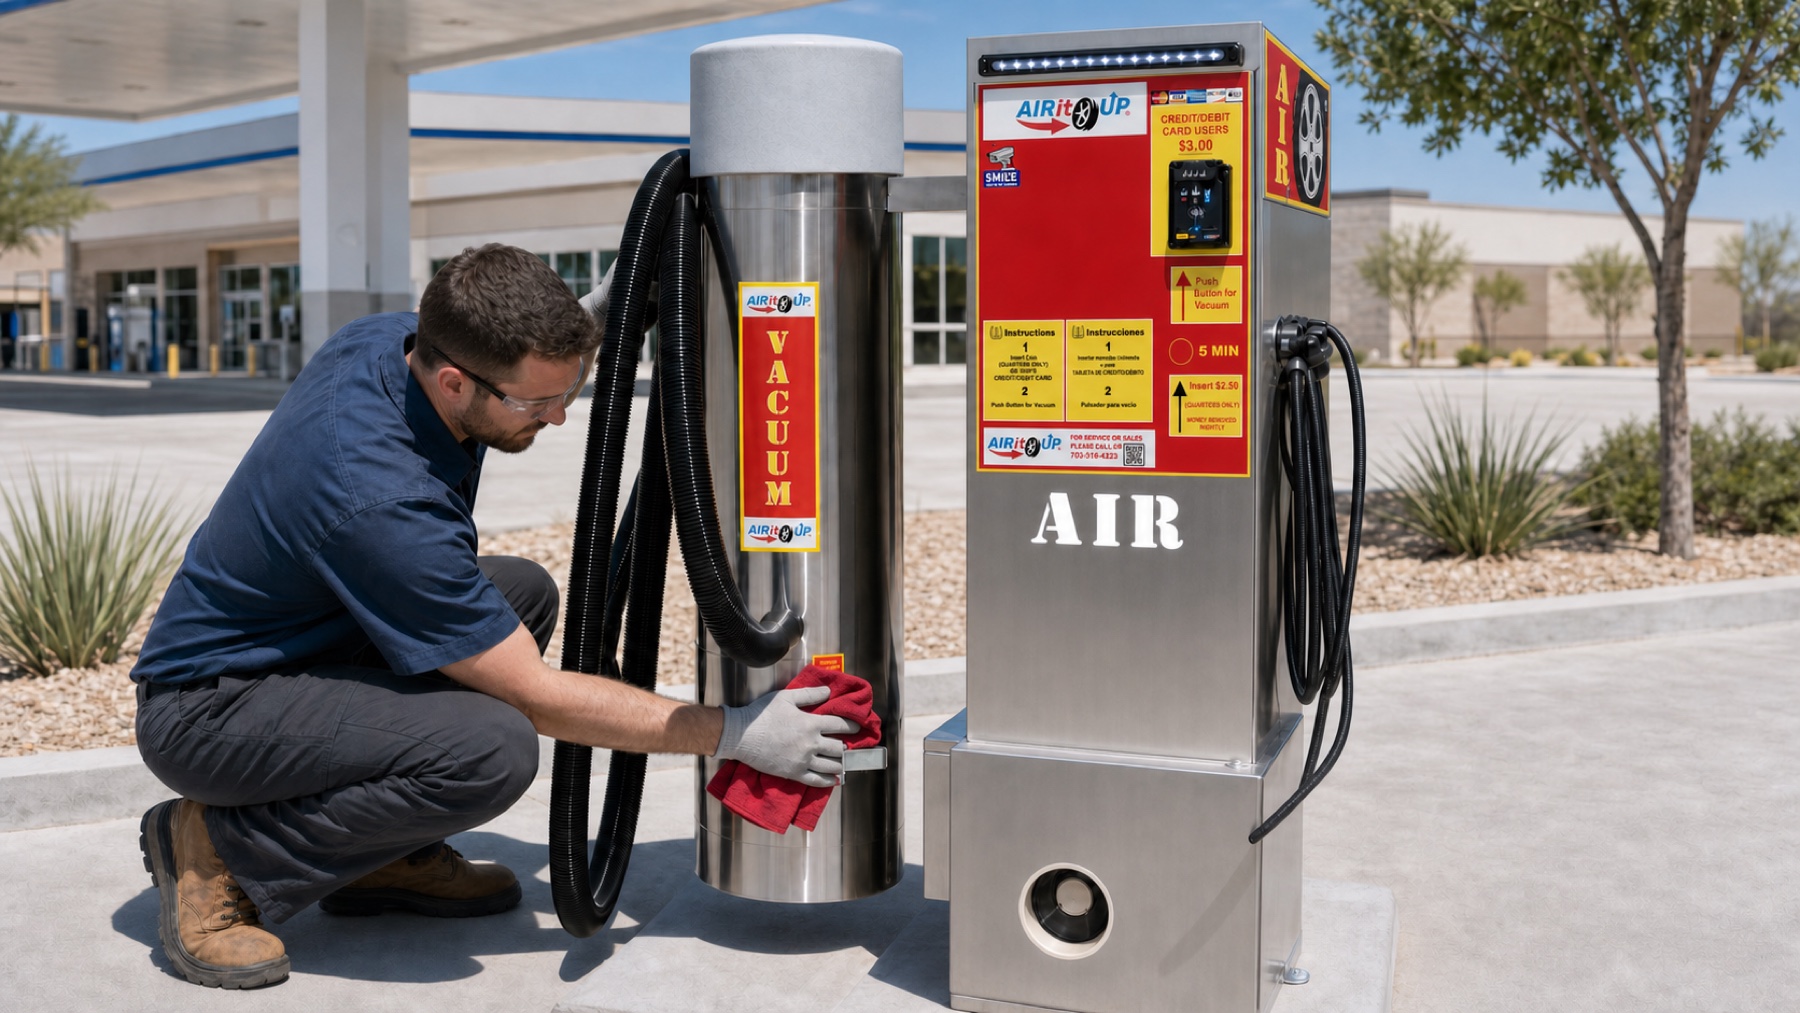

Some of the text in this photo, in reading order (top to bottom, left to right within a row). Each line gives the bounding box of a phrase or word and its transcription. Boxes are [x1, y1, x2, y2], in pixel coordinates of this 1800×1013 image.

[1161, 112, 1231, 124] CREDIT/DEBIT
[1162, 125, 1229, 136] CARD USERS
[1275, 64, 1290, 187] AIR
[1179, 139, 1213, 152] $3.00
[1195, 277, 1219, 286] Push
[1194, 288, 1237, 298] Button for
[1195, 300, 1230, 310] Vacuum
[1004, 328, 1056, 337] Instructions
[1086, 328, 1145, 336] Instrucciones
[1023, 341, 1028, 353] 1
[1105, 341, 1111, 352] 1
[1198, 345, 1239, 357] 5 MIN
[1021, 386, 1029, 396] 2
[1104, 386, 1112, 396] 2
[1189, 381, 1239, 390] Insert $2.50
[765, 330, 792, 506] VACUUM
[1030, 492, 1184, 550] AIR
